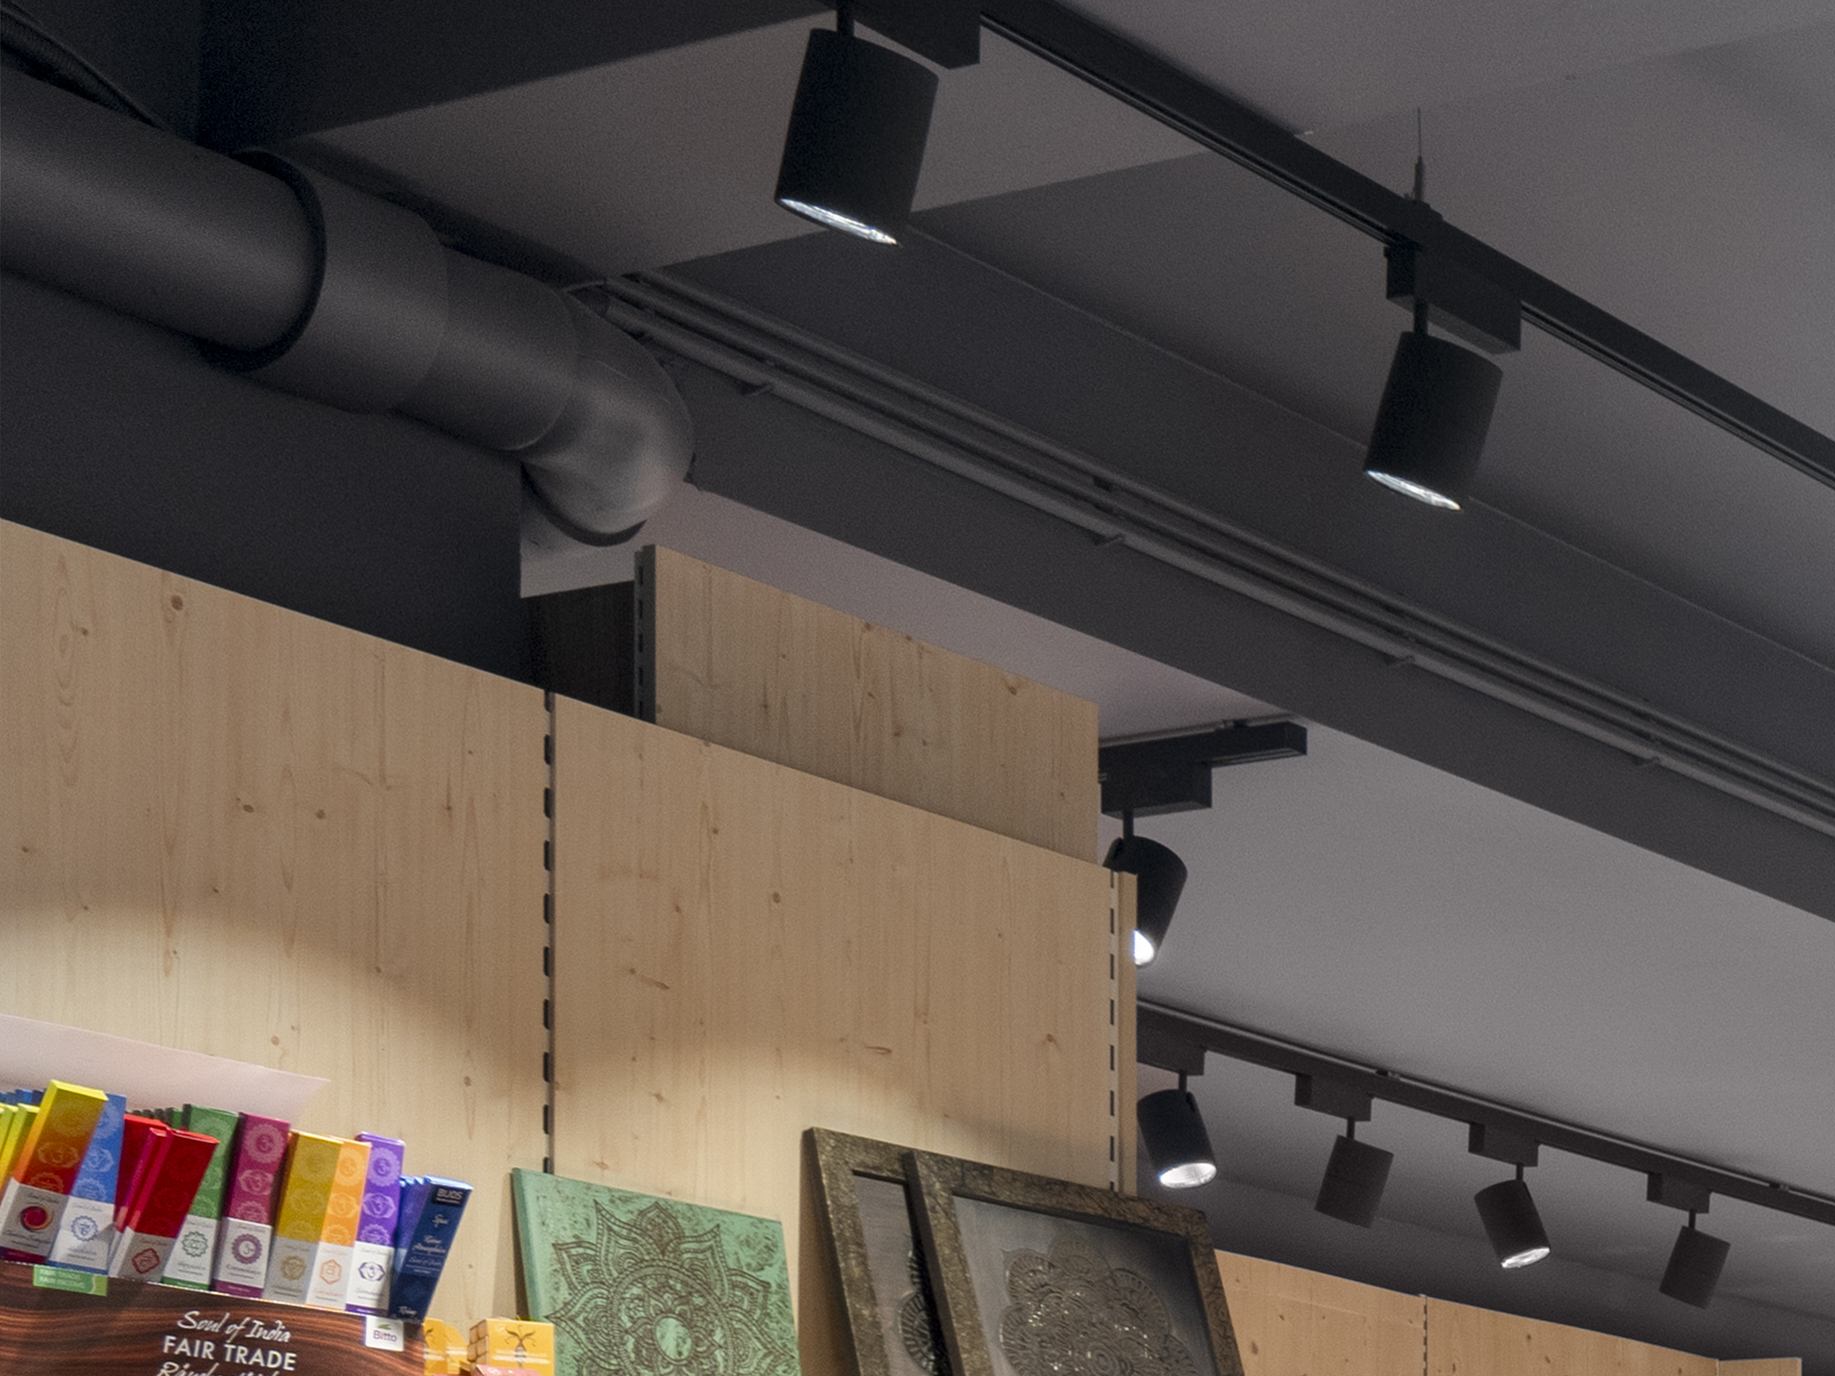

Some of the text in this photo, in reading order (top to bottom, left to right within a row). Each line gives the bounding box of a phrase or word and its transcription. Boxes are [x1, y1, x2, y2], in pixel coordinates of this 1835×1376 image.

[177, 1310, 291, 1344] Soul of India
[373, 1328, 397, 1343] Bitto
[162, 1335, 297, 1371] FAIR TRADE
